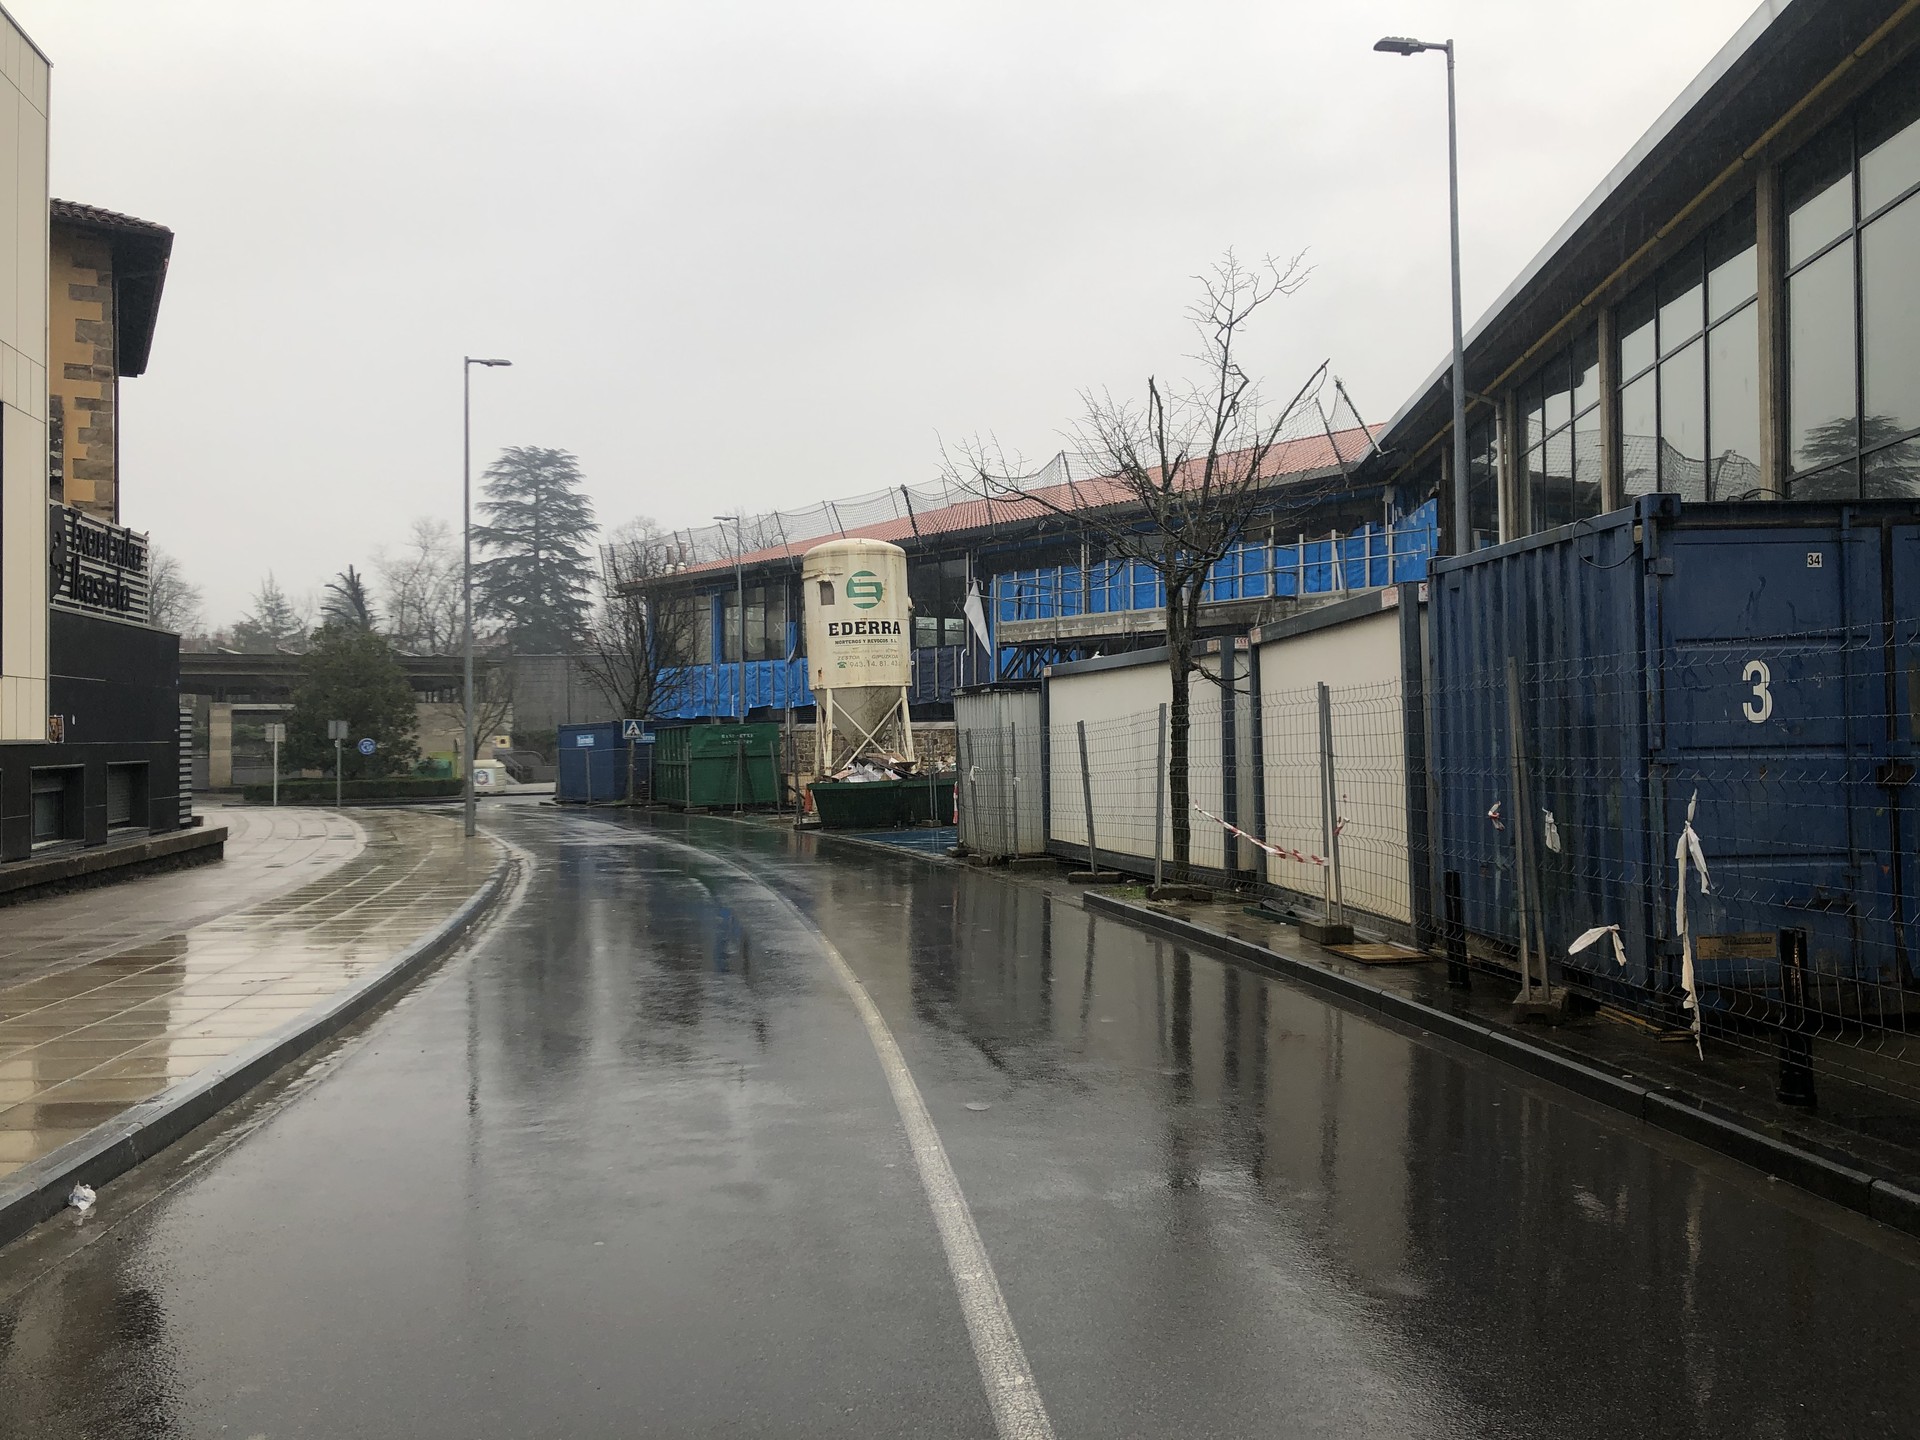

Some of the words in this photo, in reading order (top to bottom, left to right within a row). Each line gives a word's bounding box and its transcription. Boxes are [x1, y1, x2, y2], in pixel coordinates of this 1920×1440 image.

[67, 507, 142, 571] Txantxiku
[1807, 554, 1821, 566] 34
[70, 555, 130, 611] Ikastola
[828, 621, 901, 636] EDERRA
[1742, 660, 1773, 723] 3
